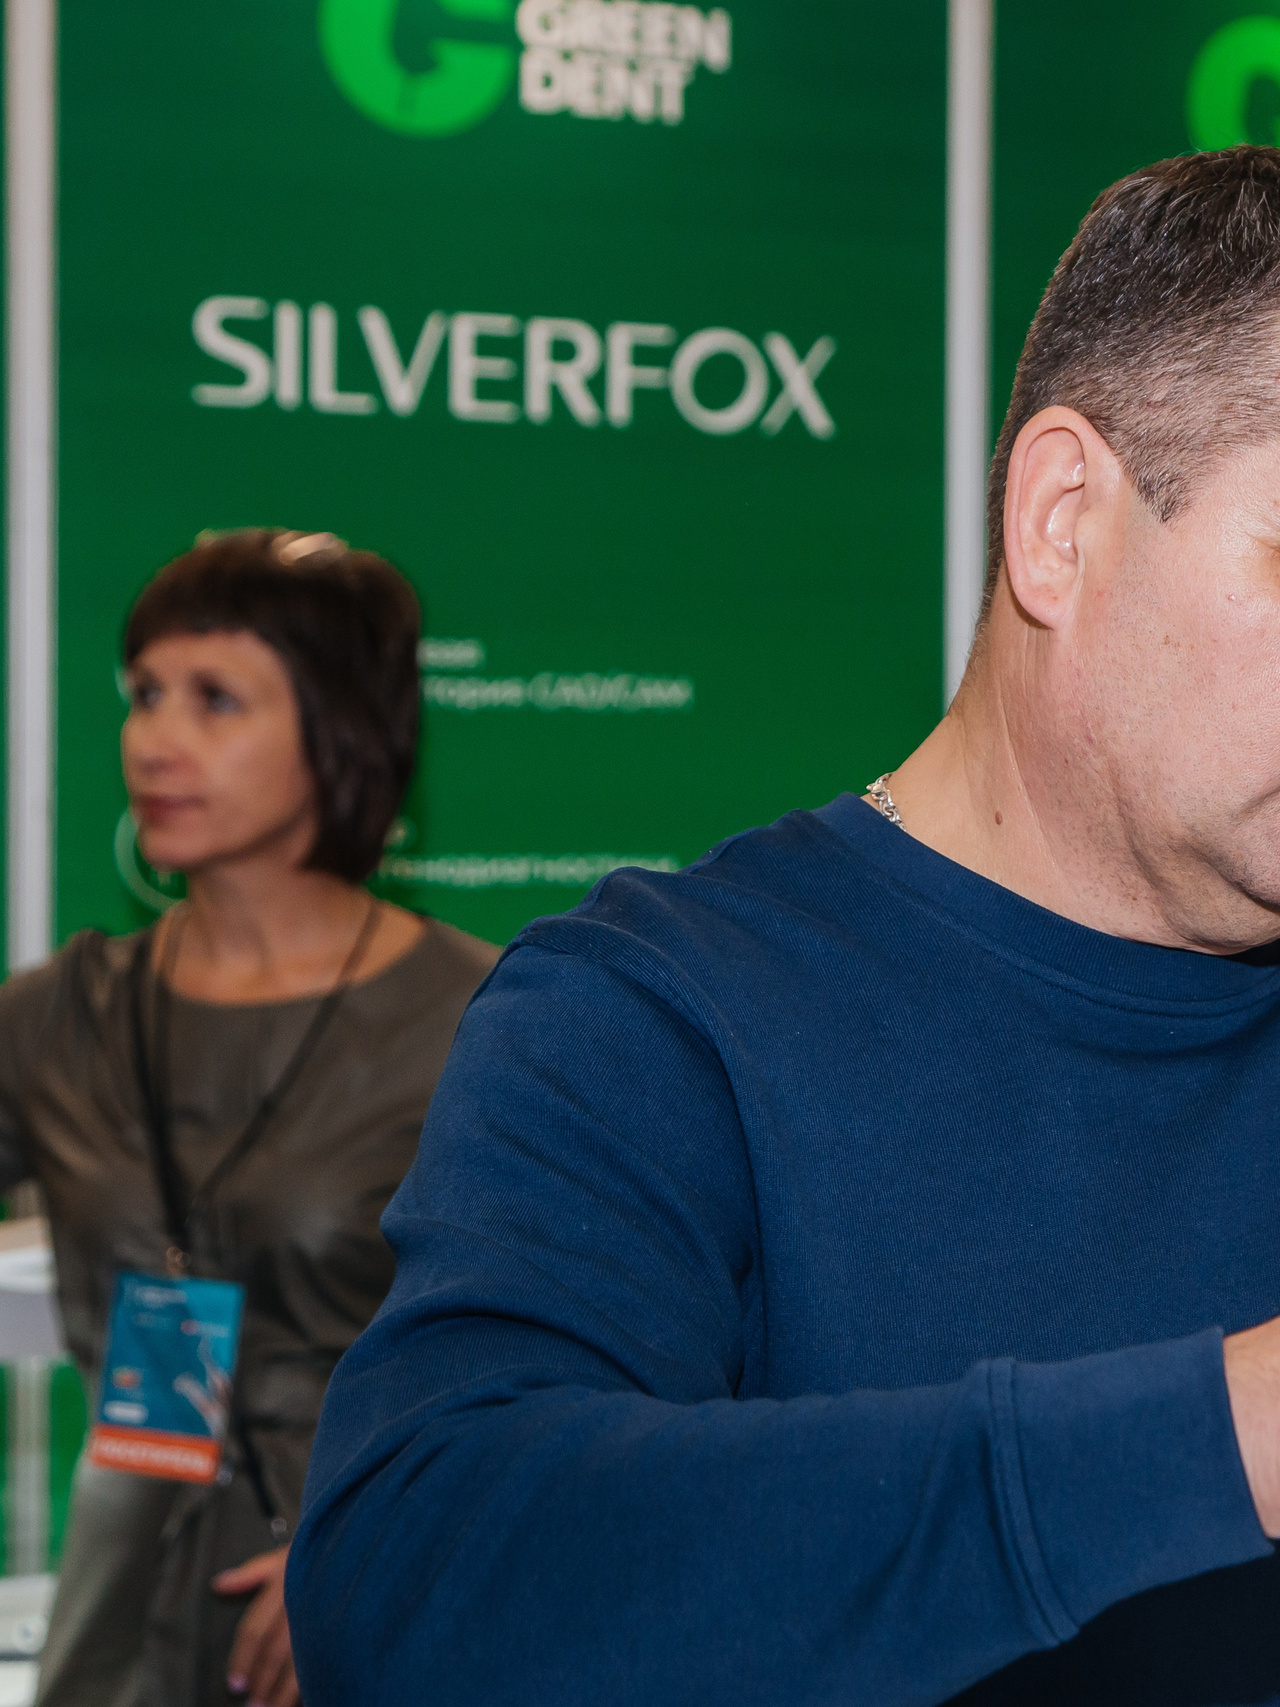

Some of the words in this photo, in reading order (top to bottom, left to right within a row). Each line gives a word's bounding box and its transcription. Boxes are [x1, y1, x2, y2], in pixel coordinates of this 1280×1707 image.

[516, 0, 732, 72] GREEN
[519, 48, 696, 126] DENT
[191, 295, 838, 440] SILVERFOX
